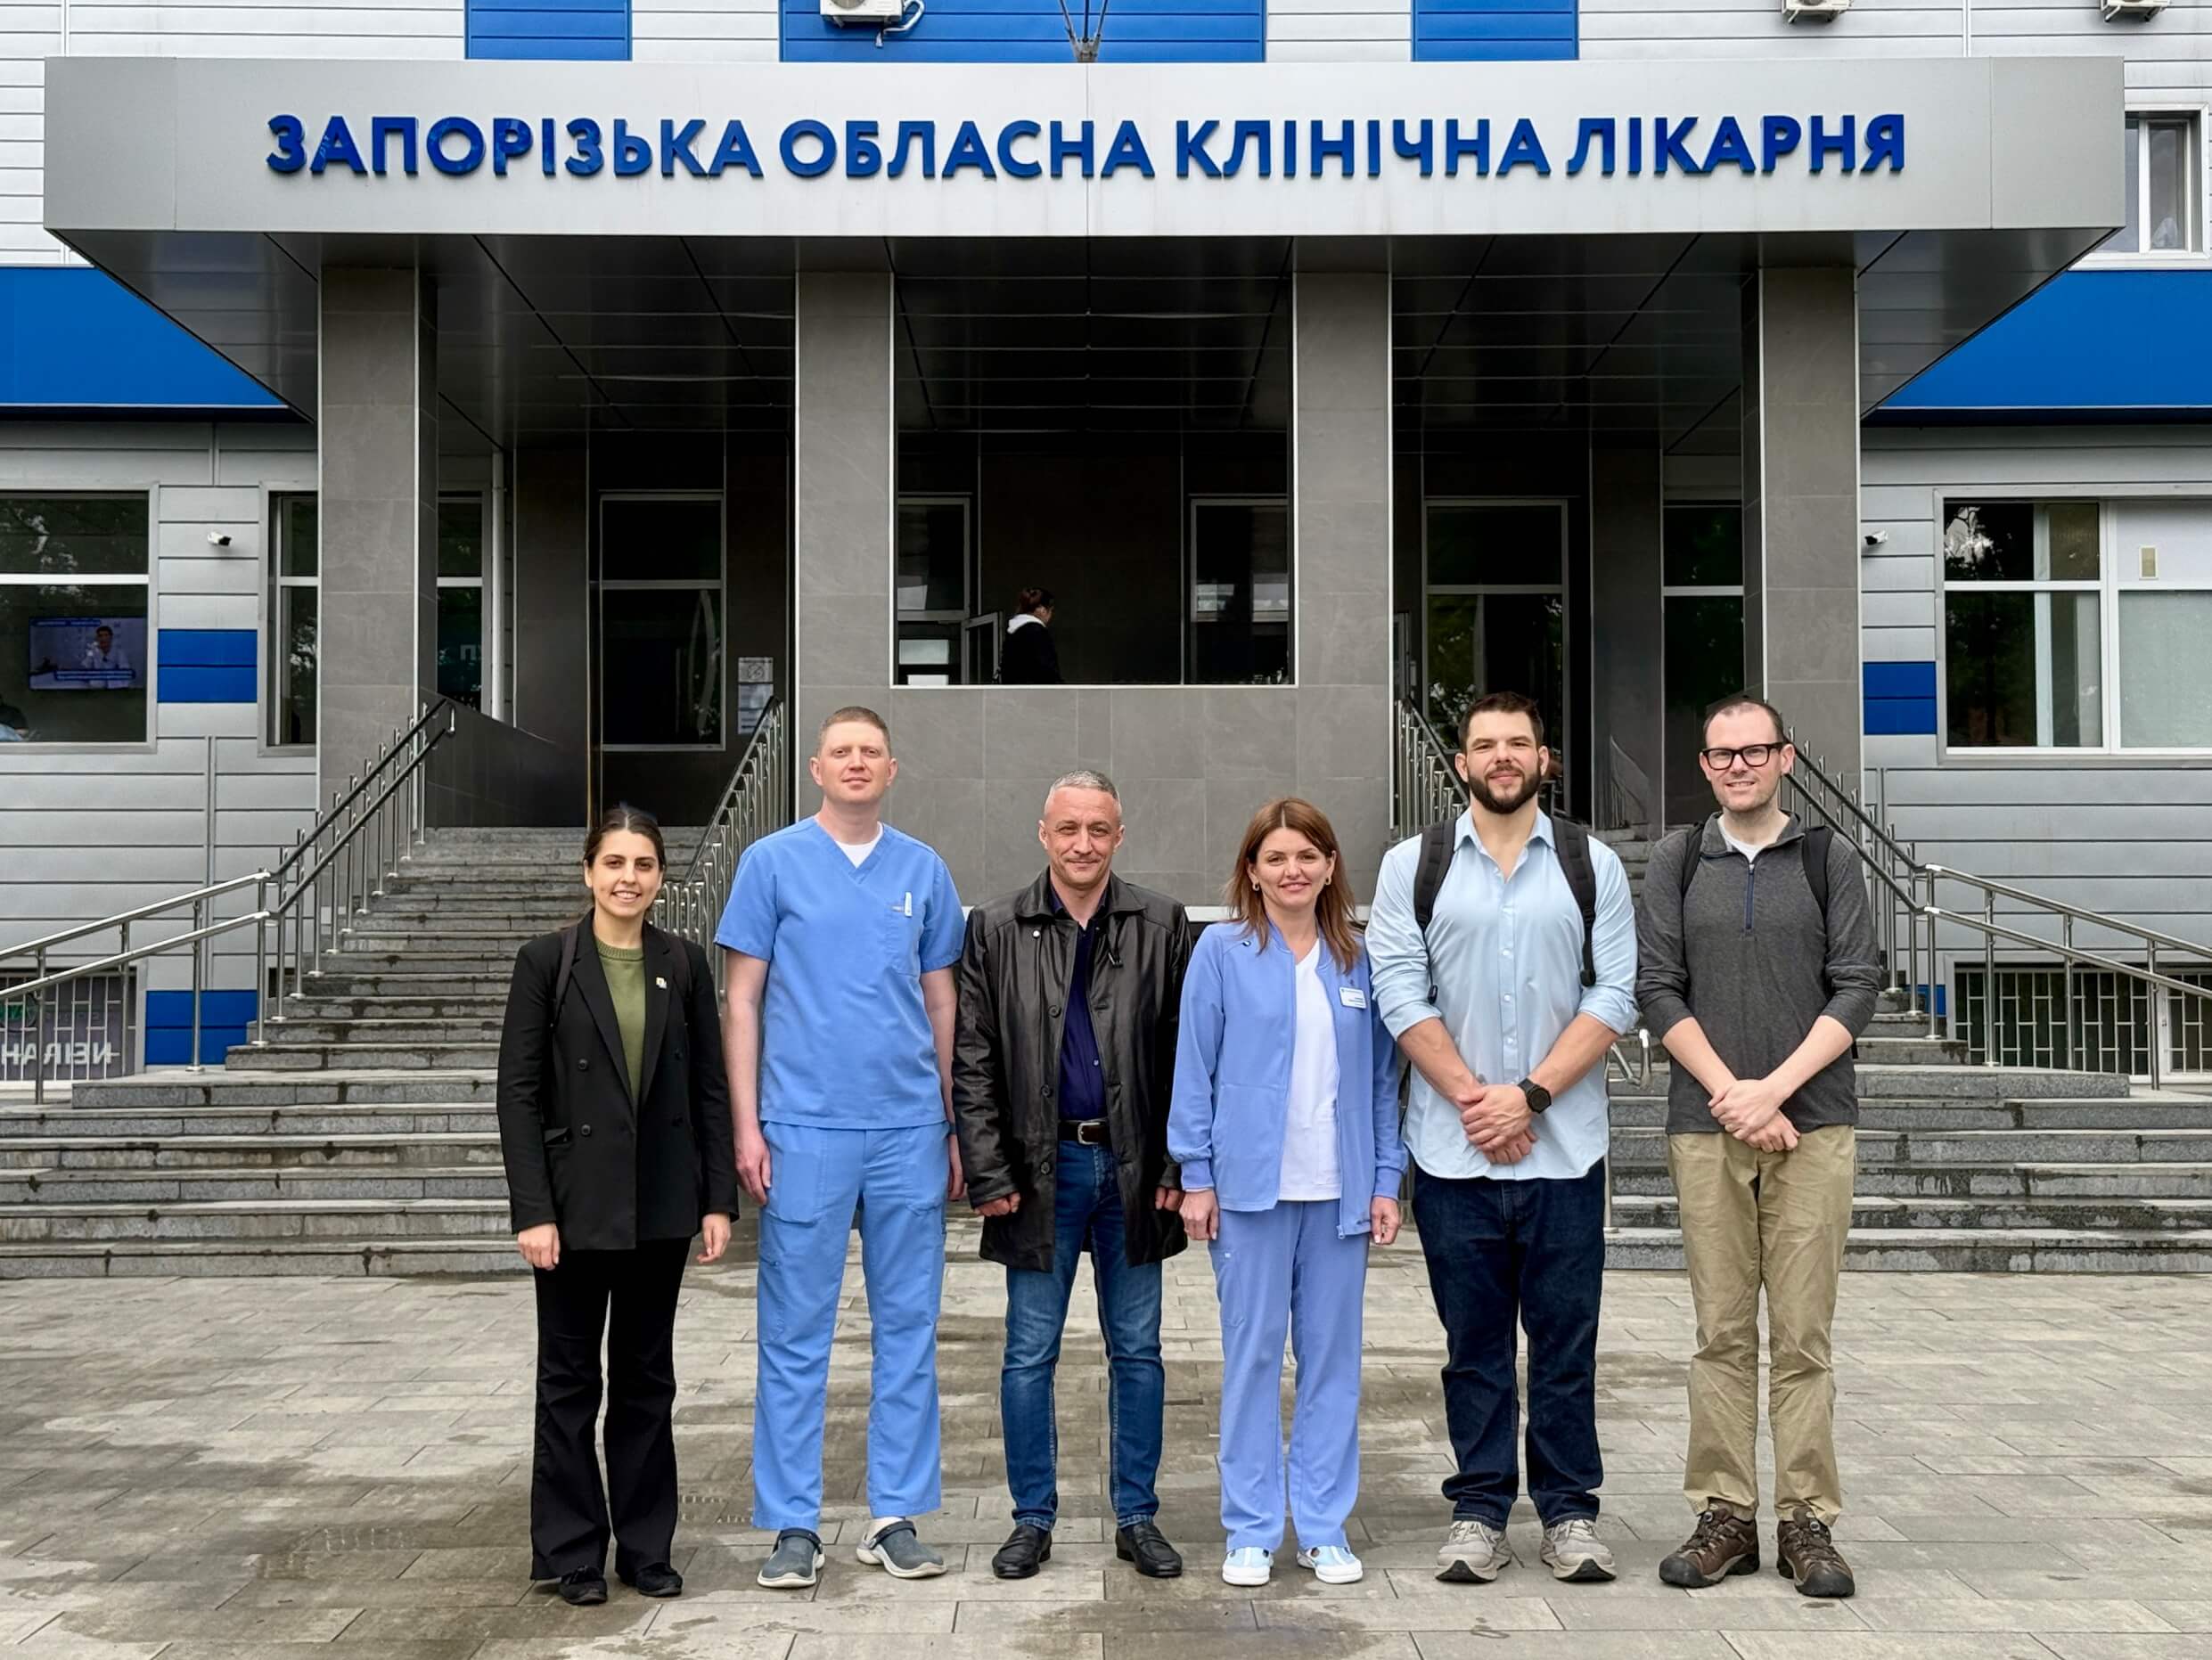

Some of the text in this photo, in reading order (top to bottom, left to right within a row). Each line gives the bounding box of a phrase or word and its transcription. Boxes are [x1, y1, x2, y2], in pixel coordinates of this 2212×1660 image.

[266, 113, 1905, 178] ЗАПОРІЗЬКА ОБЛАСНА КЛІНІЧНА ЛІКАРНЯ
